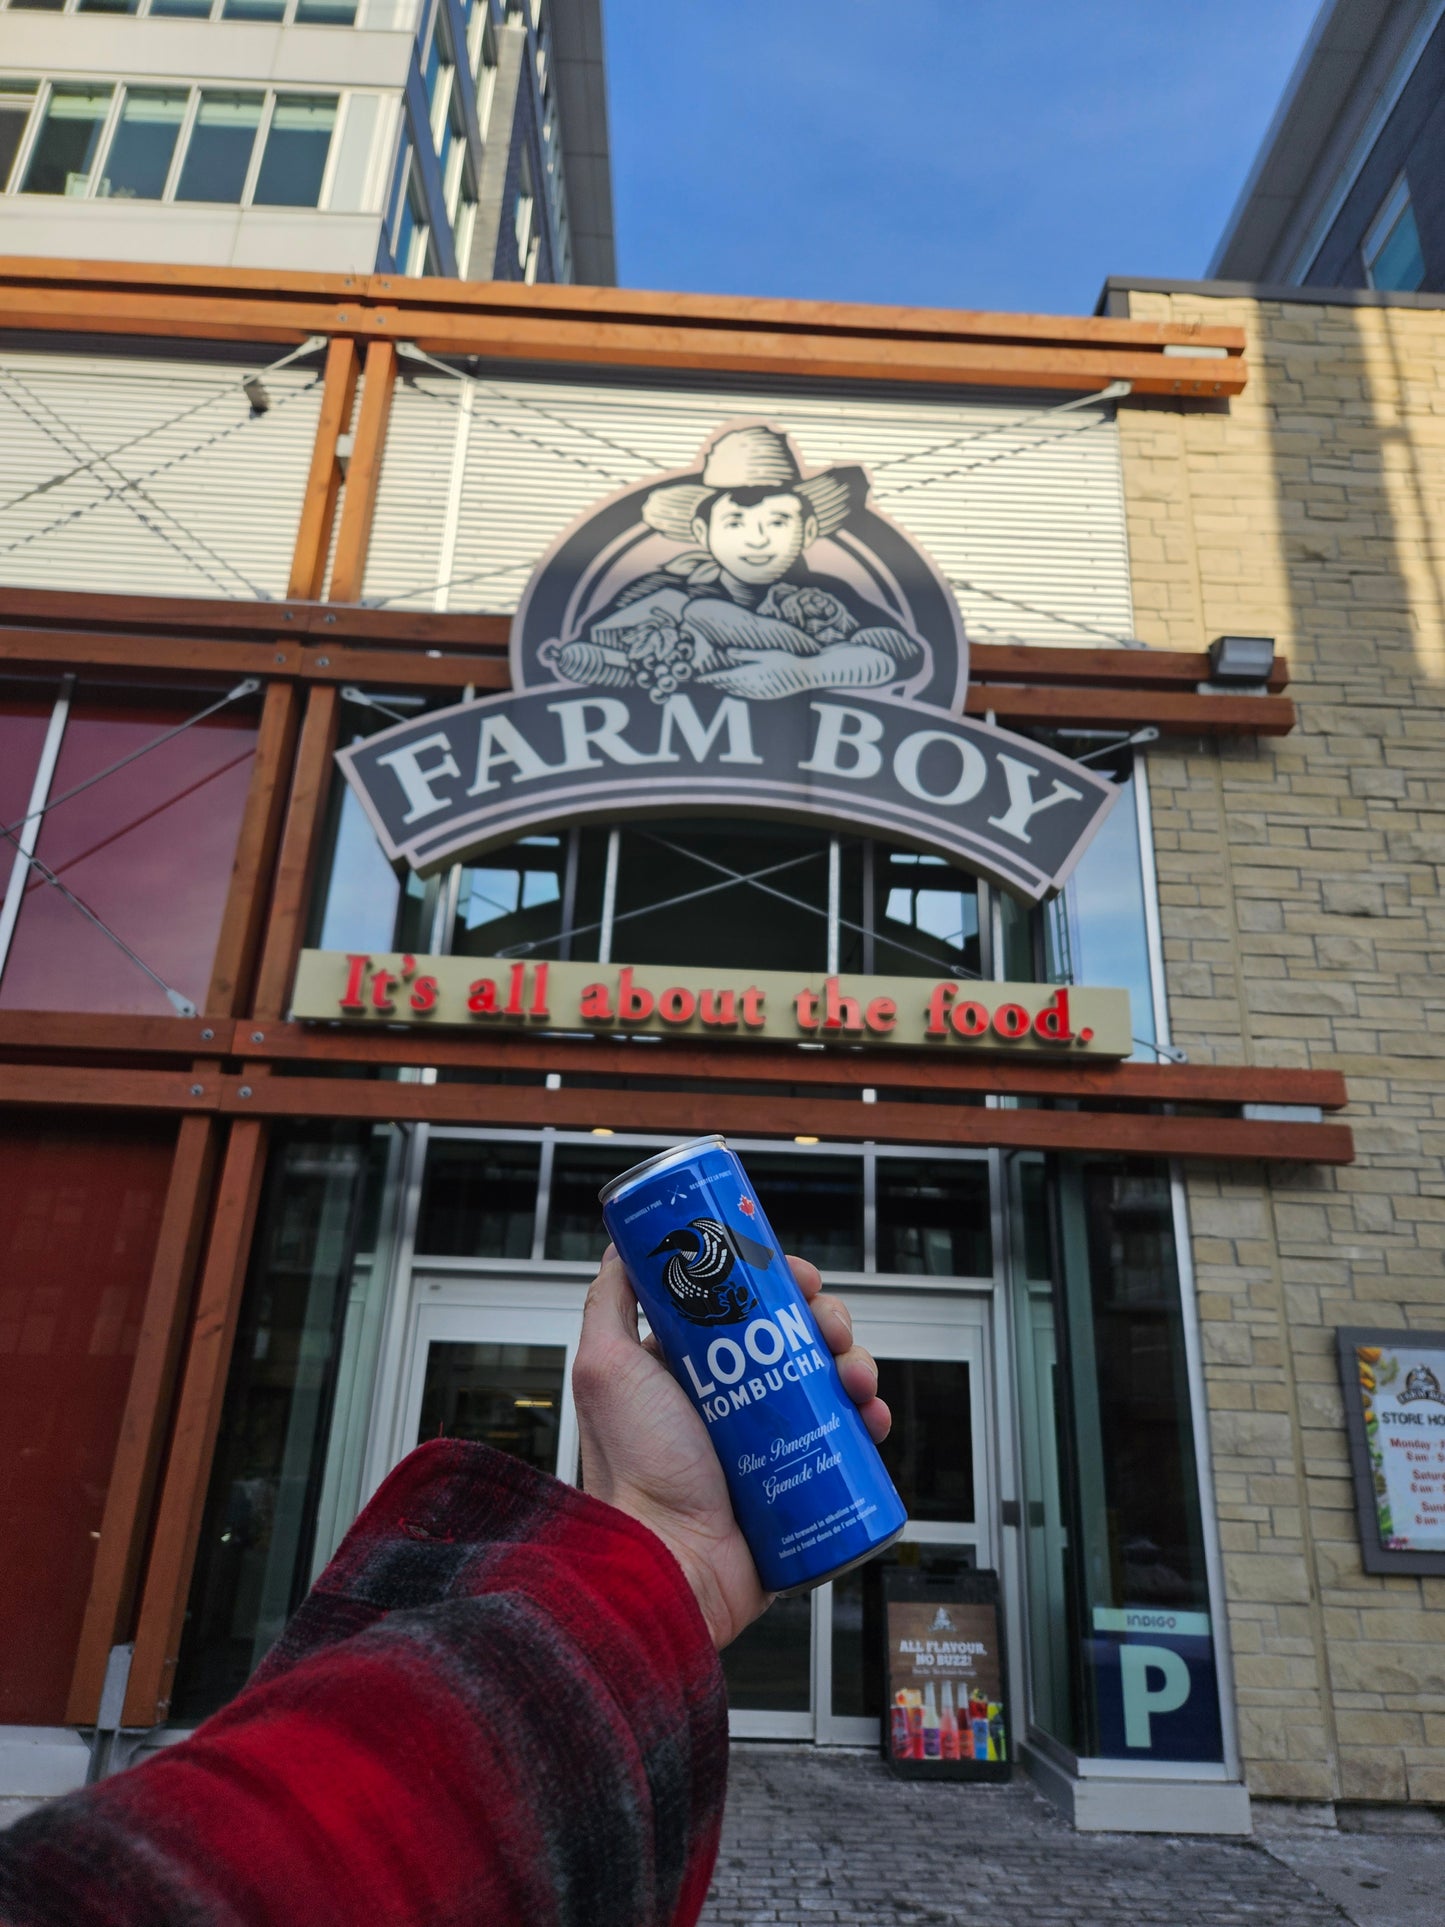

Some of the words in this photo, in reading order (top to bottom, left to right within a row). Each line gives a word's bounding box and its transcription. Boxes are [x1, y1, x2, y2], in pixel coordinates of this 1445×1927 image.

[376, 694, 765, 825] FARM
[800, 702, 1086, 845] BOY
[338, 953, 438, 1012] It's
[467, 961, 549, 1016] all
[578, 966, 767, 1028] about
[793, 975, 898, 1032] the
[924, 982, 1094, 1042] food.
[681, 1302, 815, 1399] LOON
[702, 1349, 826, 1423] KOMBUCHA
[738, 1453, 767, 1476] Blue
[769, 1412, 841, 1462] Pomegranate
[1381, 1411, 1424, 1425] STORE
[1389, 1438, 1431, 1451] Monday
[762, 1463, 813, 1504] Grenade
[816, 1451, 842, 1474] bleue
[899, 1640, 924, 1653] ALL
[926, 1641, 988, 1656] FLAVOUR,
[1126, 1614, 1177, 1629] INDIGO
[915, 1653, 935, 1666] NO
[1119, 1644, 1191, 1748] P
